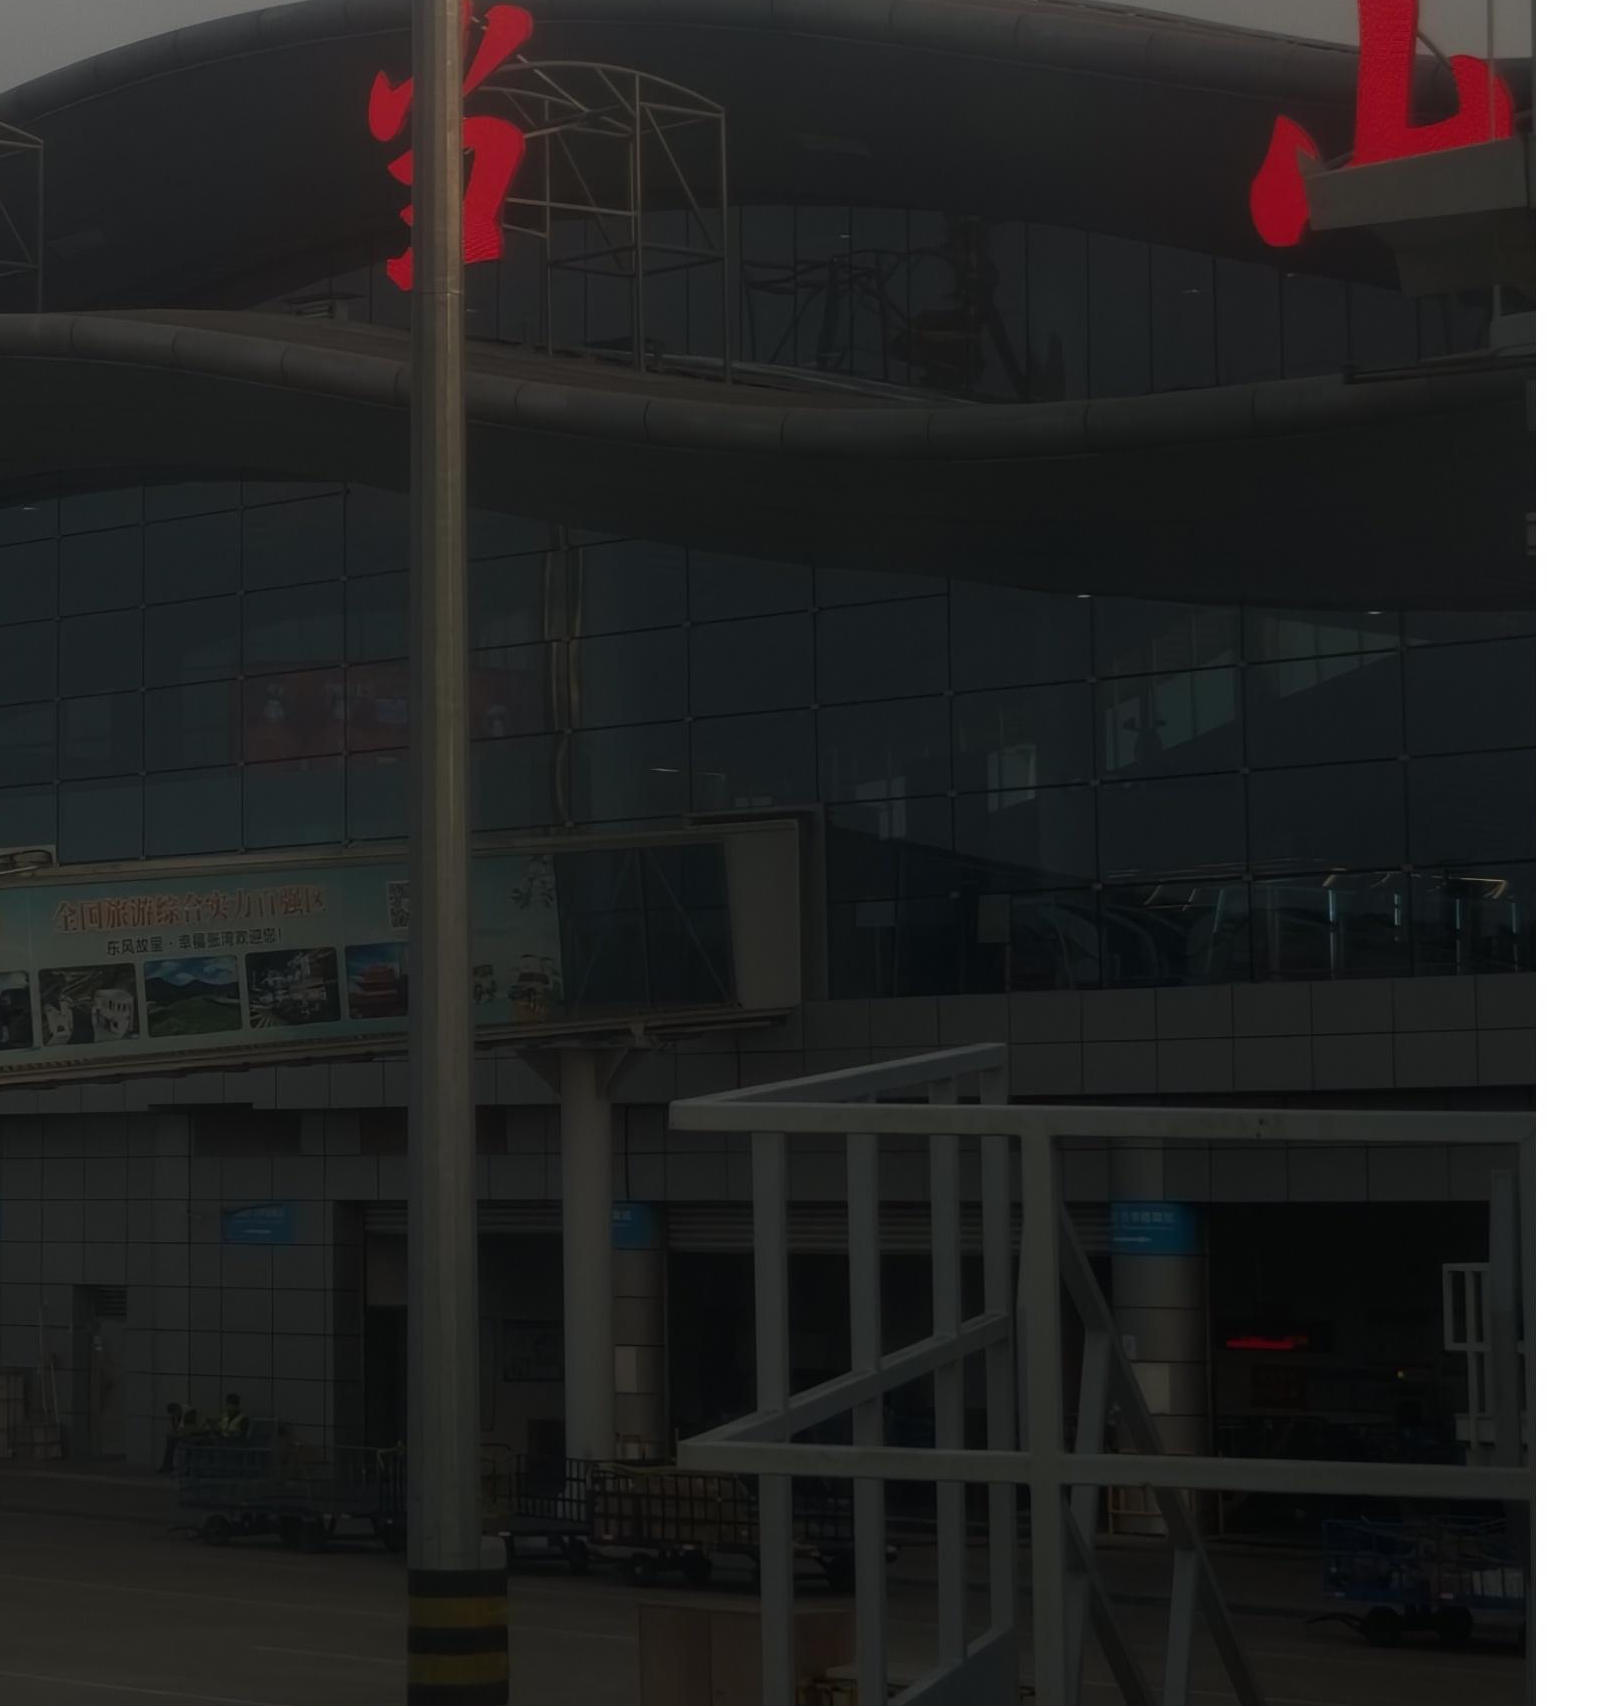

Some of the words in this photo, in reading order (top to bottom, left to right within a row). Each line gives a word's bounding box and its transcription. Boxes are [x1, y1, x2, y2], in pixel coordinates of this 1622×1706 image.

[55, 886, 327, 932] 全国旅游综合实力百强区
